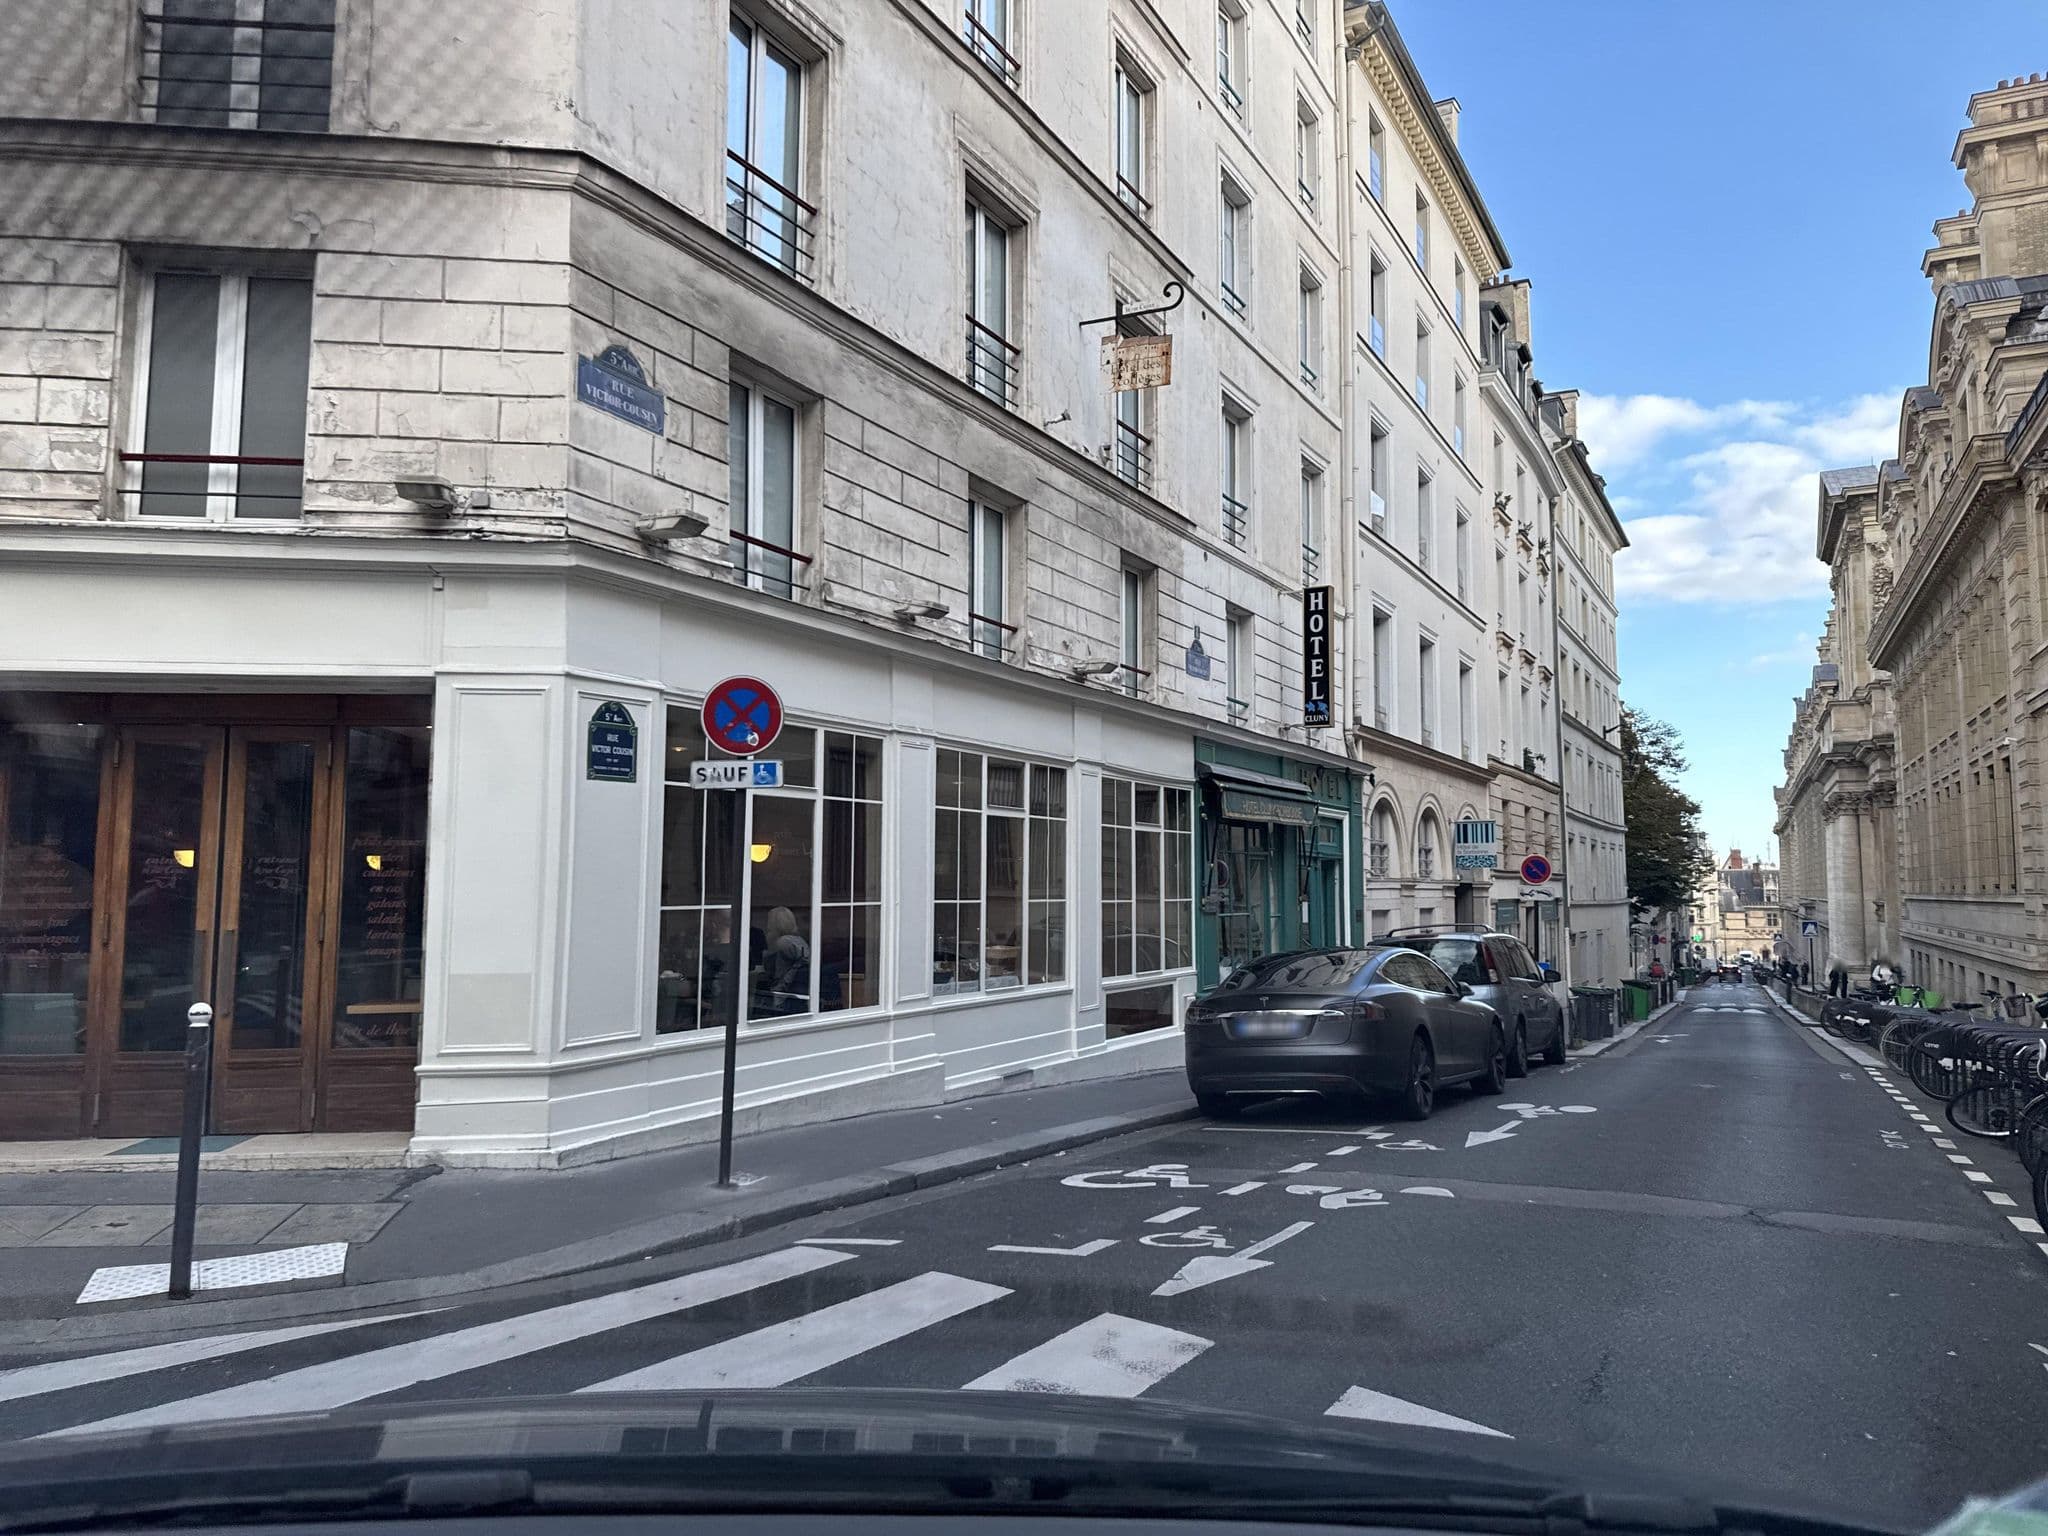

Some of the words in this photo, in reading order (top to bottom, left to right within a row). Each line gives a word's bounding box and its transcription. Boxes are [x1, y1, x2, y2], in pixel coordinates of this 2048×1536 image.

[612, 380, 635, 399] RUE
[1309, 591, 1325, 700] HOTEL
[1304, 713, 1329, 723] CLUNY
[607, 733, 619, 743] RUE
[591, 744, 611, 754] VICTOR
[612, 746, 634, 756] COUSIN
[696, 766, 748, 783] SAUF
[1300, 767, 1342, 800] HOTEL
